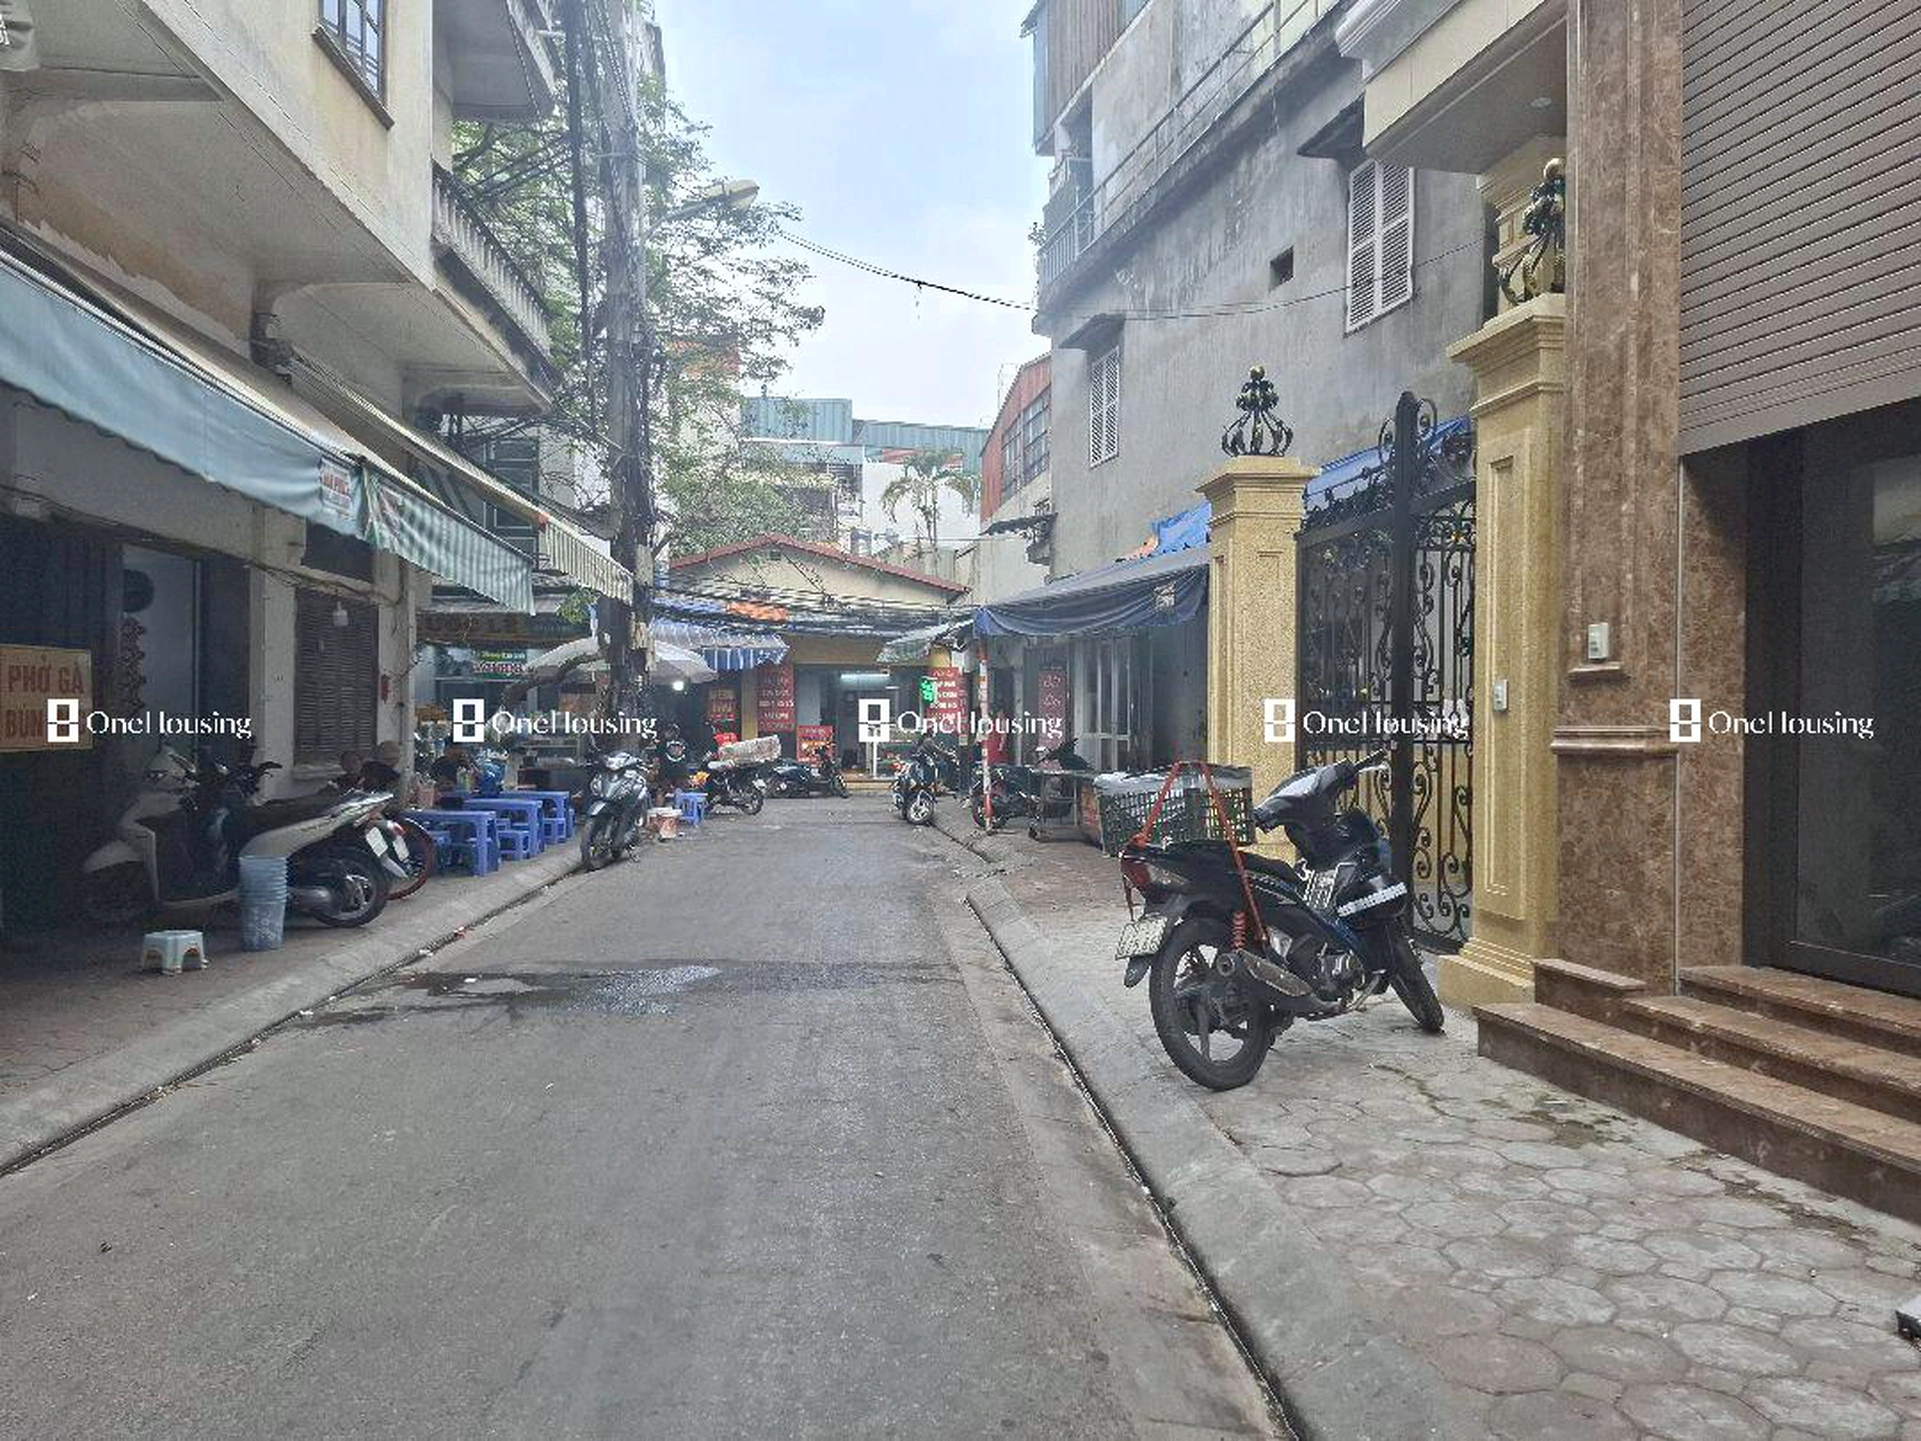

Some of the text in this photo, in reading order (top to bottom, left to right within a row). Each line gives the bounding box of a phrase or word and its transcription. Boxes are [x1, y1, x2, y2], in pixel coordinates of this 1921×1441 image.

[8, 654, 85, 694] PHỞ GÀ
[5, 703, 44, 738] BÚN
